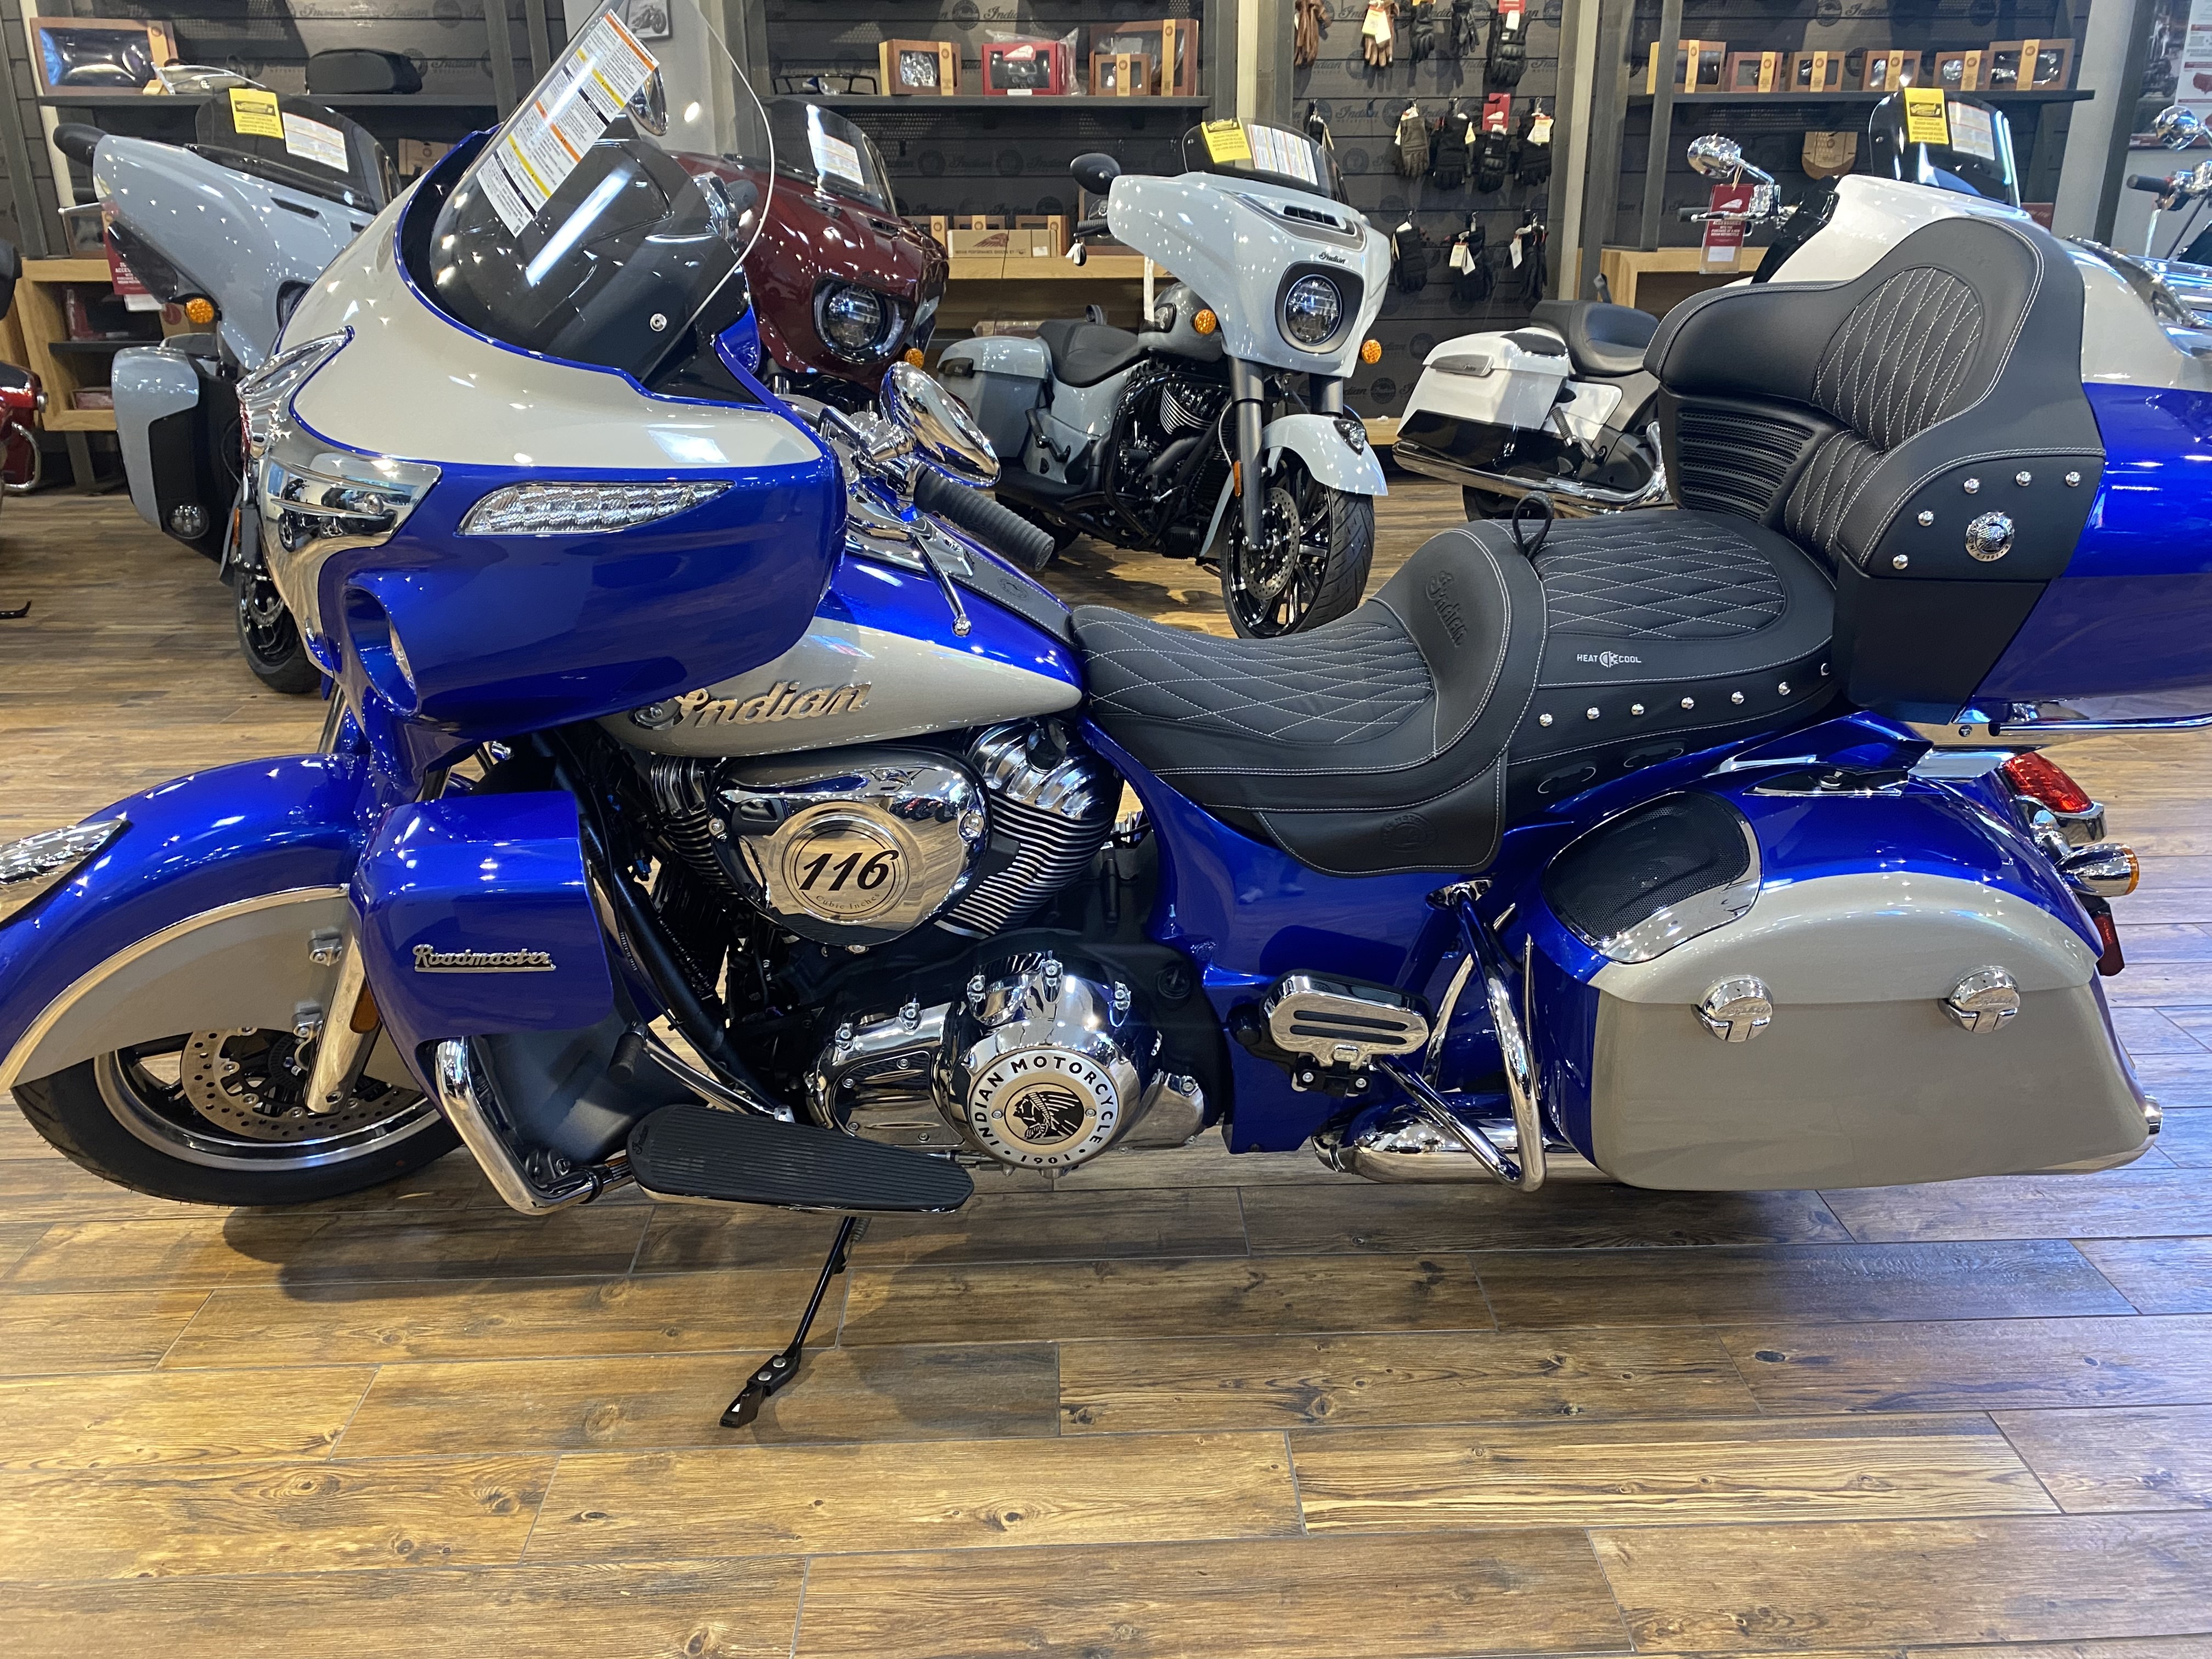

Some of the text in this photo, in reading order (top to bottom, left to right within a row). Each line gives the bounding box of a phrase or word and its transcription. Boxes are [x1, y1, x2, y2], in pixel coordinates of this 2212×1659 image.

[1318, 251, 1346, 264] Indian
[1426, 570, 1468, 648] Indian
[1576, 653, 1642, 663] HEAT COOL
[630, 680, 872, 730] Indian
[799, 850, 900, 891] 116
[816, 892, 881, 910] Cubic Inches
[412, 944, 554, 970] Roadmaster
[974, 1056, 1114, 1147] INDIAN MOTORCYCLE
[1020, 1154, 1071, 1164] 1901
